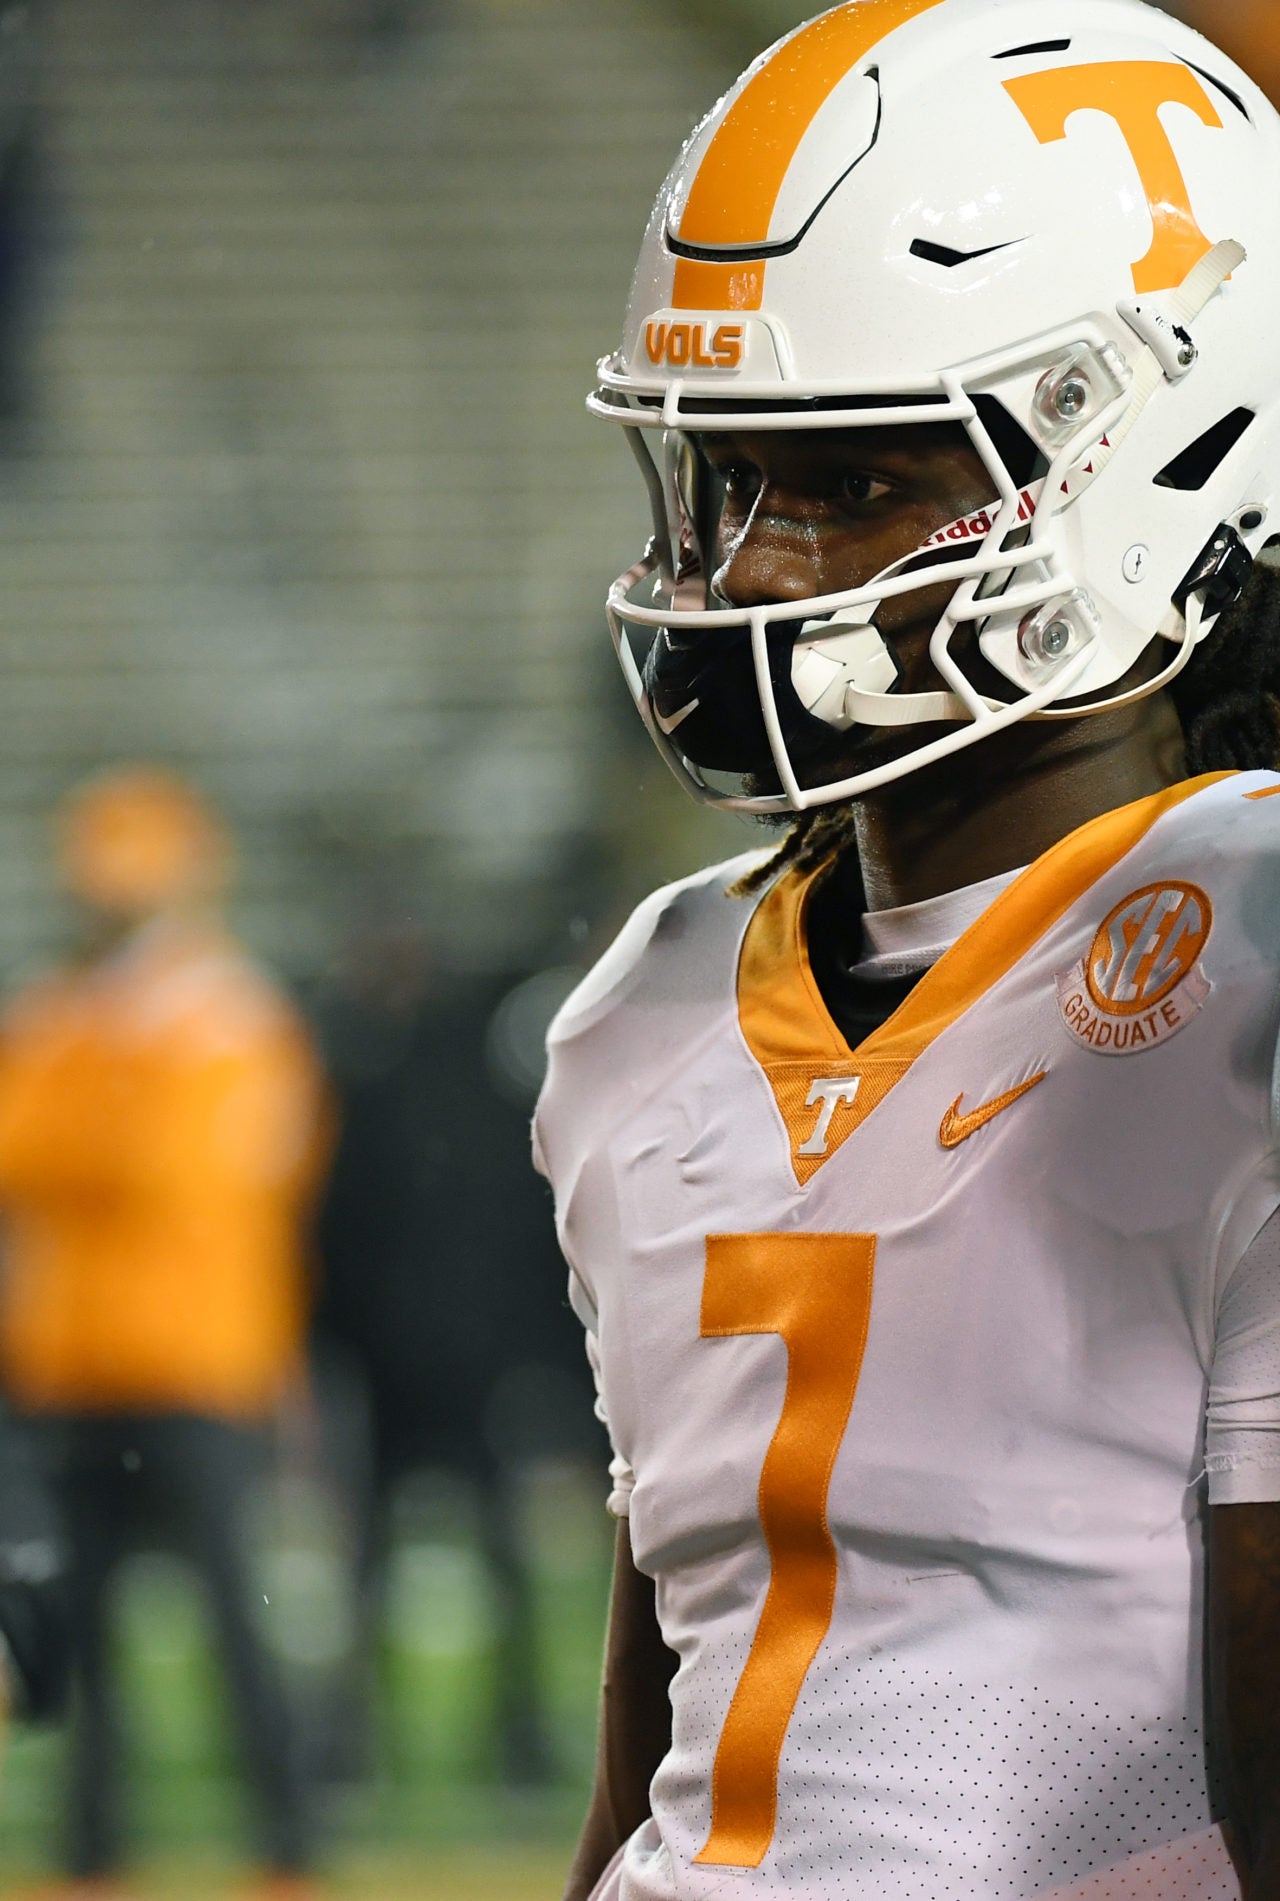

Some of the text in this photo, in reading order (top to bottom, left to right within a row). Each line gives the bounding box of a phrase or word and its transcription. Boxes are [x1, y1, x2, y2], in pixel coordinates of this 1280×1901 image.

[1000, 60, 1232, 295] T
[645, 322, 744, 369] VOLS
[919, 489, 1037, 548] iddll
[1093, 889, 1203, 1003] SEC
[1064, 993, 1182, 1049] GRADUATE
[797, 1075, 862, 1155] T
[691, 1231, 877, 1869] 7
